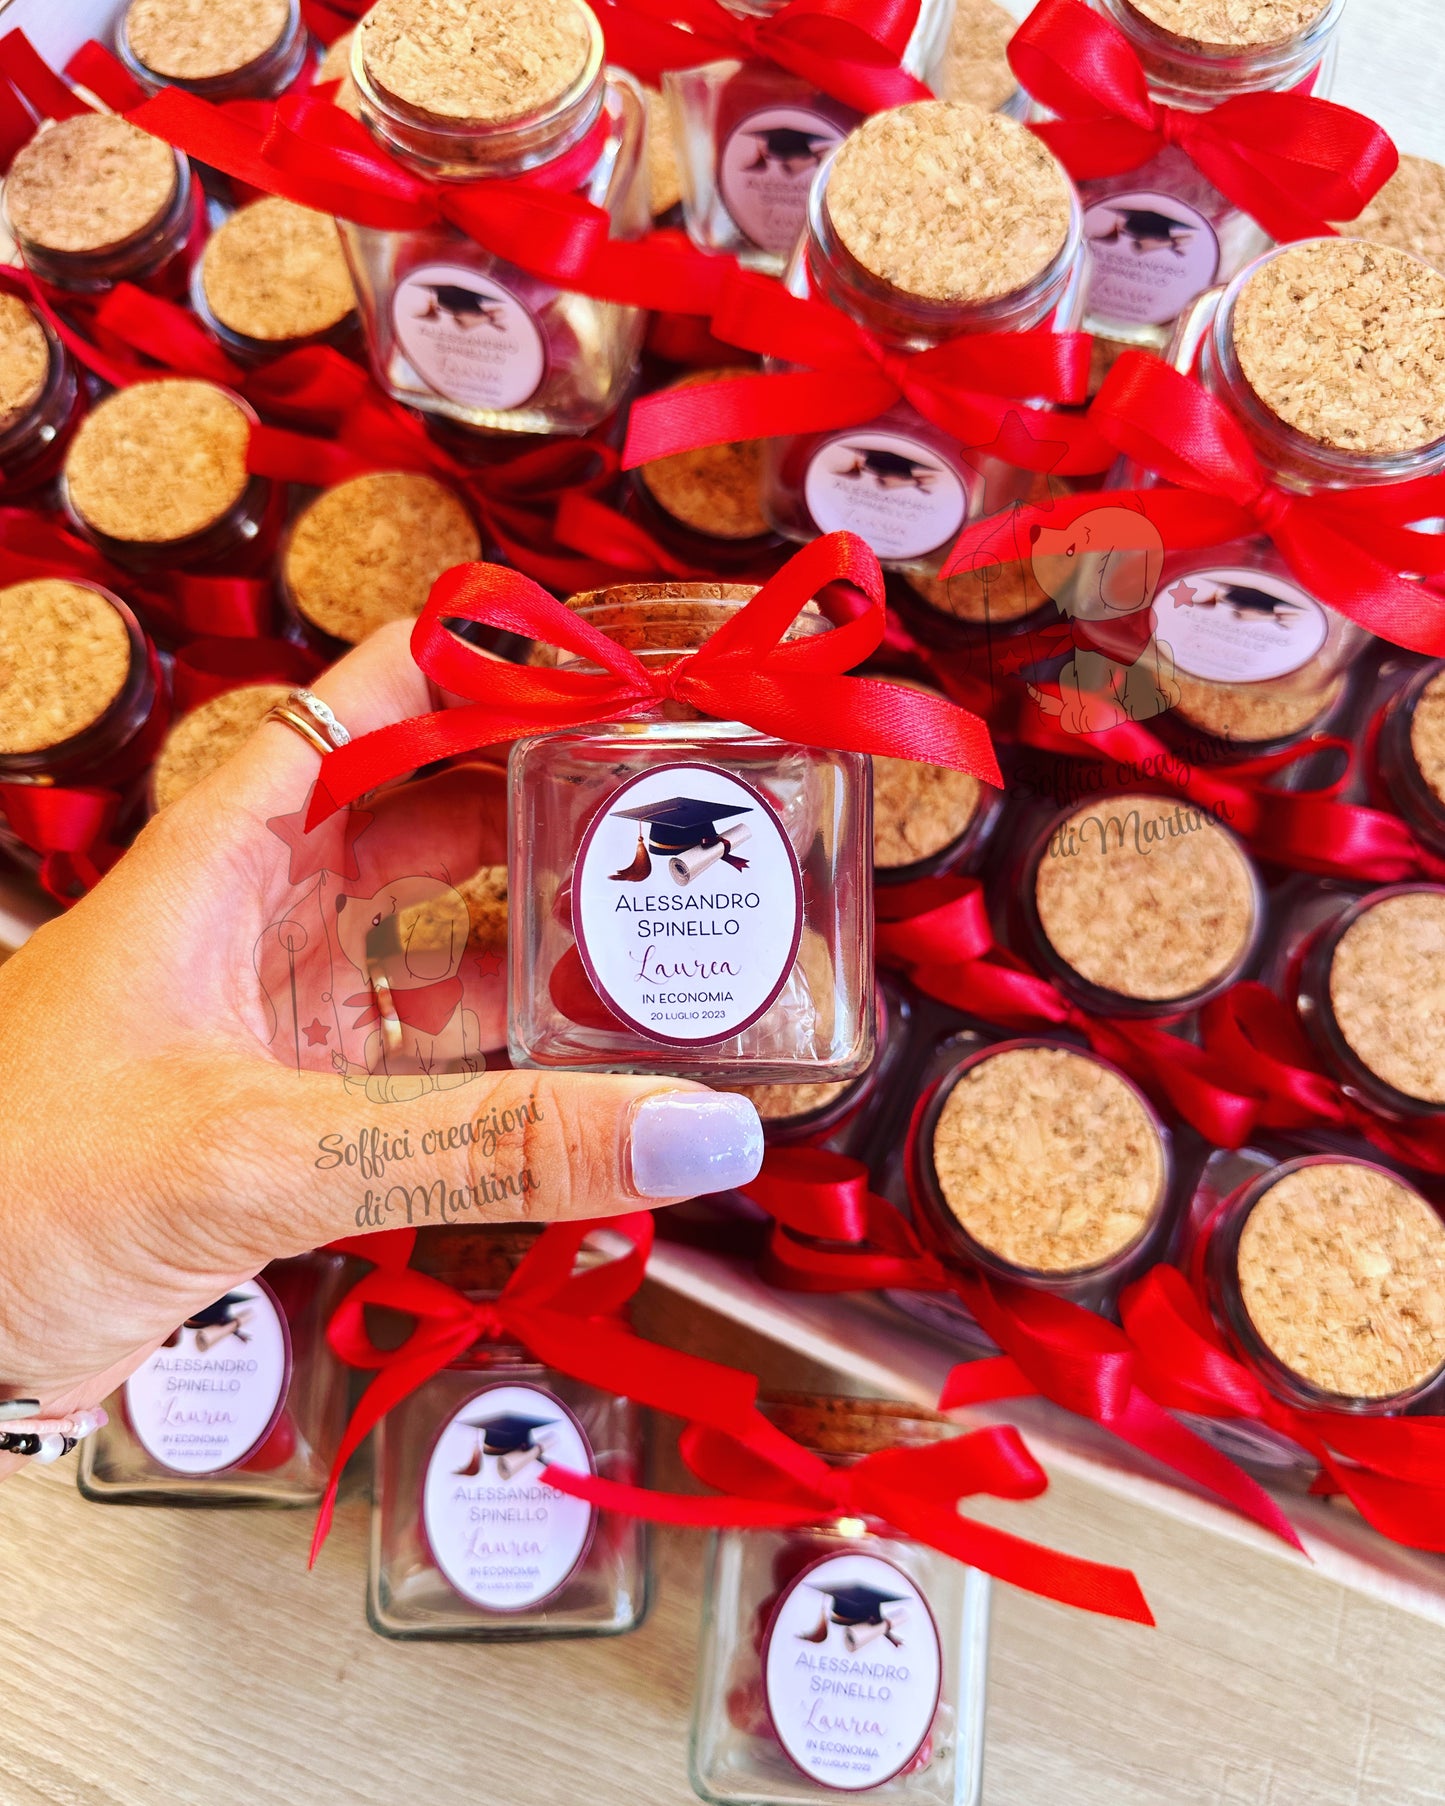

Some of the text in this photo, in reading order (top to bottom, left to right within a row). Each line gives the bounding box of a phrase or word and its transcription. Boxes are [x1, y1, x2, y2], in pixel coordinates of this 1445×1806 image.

[615, 892, 760, 912] ALESSANDRO
[637, 919, 740, 938] SPINELLO
[629, 944, 742, 985] Laurea
[642, 991, 734, 1005] IN ECONOMIA
[650, 1010, 726, 1021] 20 LUGLIO 2023
[153, 1357, 258, 1372] ALESSANDRO
[166, 1376, 241, 1392] SPINELLO
[469, 1506, 549, 1523] SPINELLO
[795, 1651, 911, 1682] ALESSANDRO
[810, 1675, 892, 1701] SPINELLO
[806, 1738, 880, 1760] IN ECONOMIA
